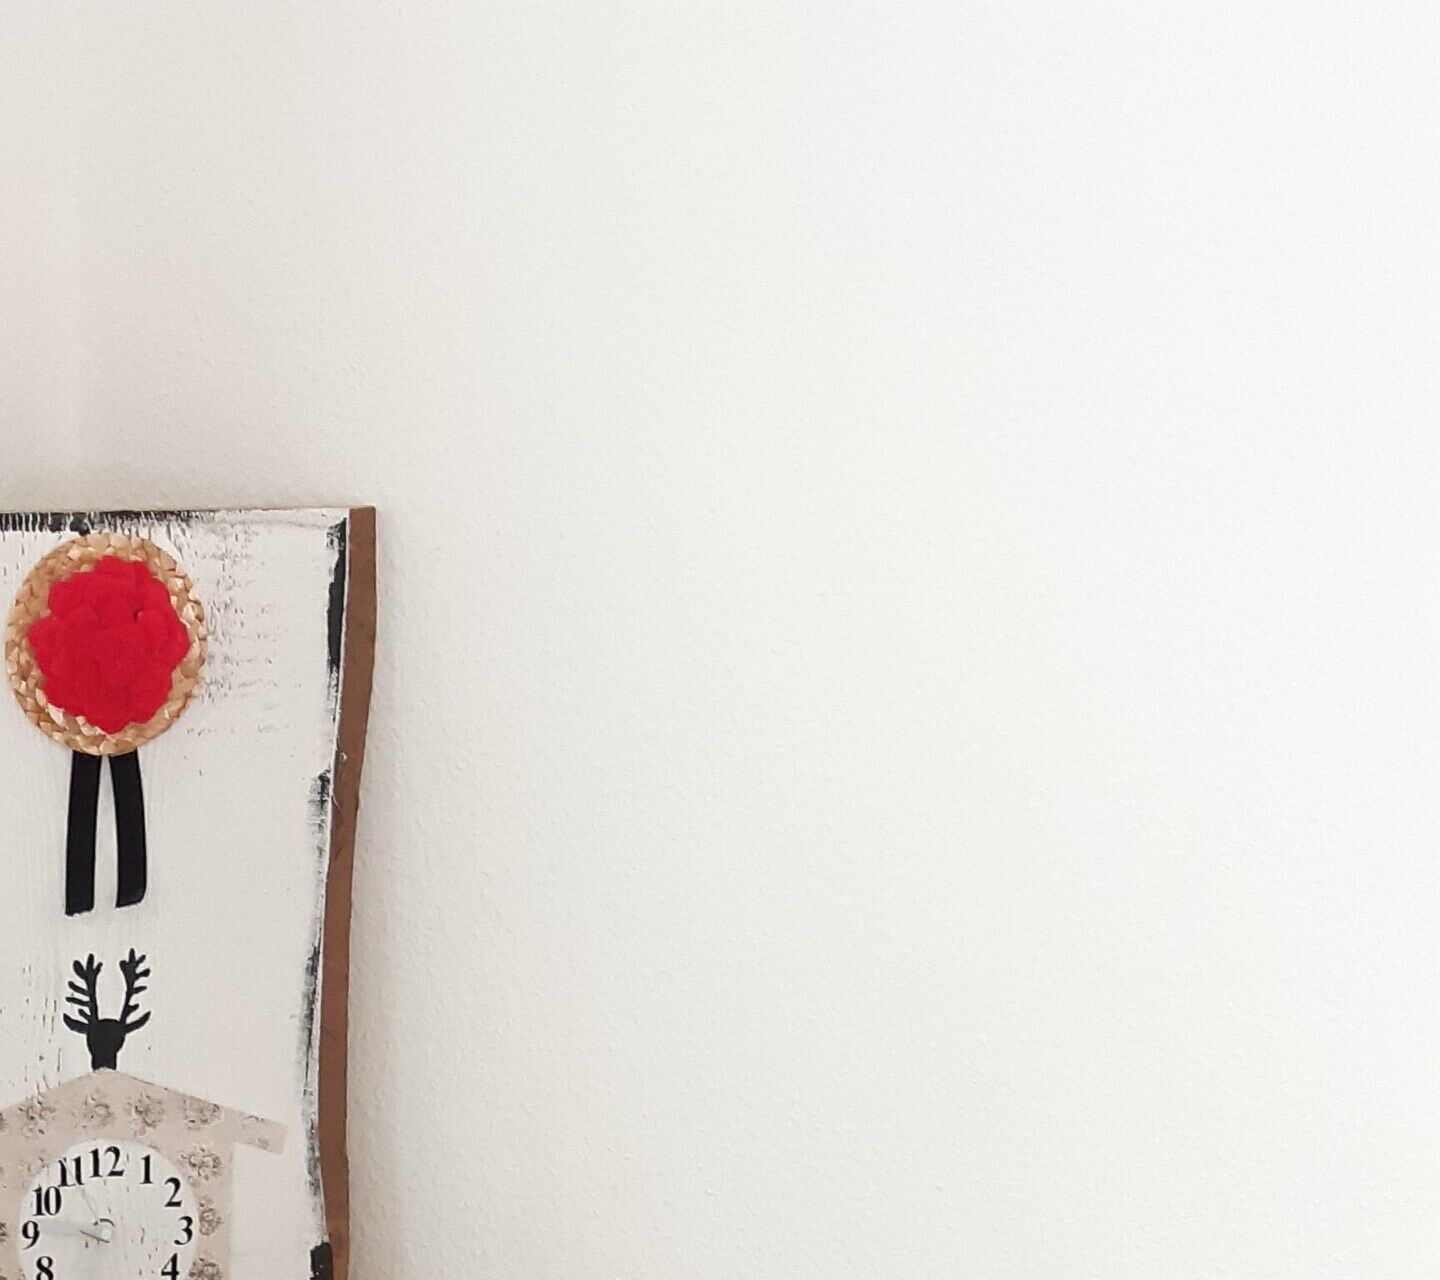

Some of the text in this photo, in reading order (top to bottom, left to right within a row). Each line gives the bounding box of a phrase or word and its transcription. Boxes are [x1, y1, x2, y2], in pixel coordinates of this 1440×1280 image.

[59, 1155, 85, 1187] 11
[89, 1146, 124, 1178] 12
[140, 1154, 154, 1185] 1
[32, 1185, 61, 1217] 10
[164, 1178, 182, 1207] 2
[22, 1220, 40, 1249] 9
[174, 1216, 193, 1246] 3
